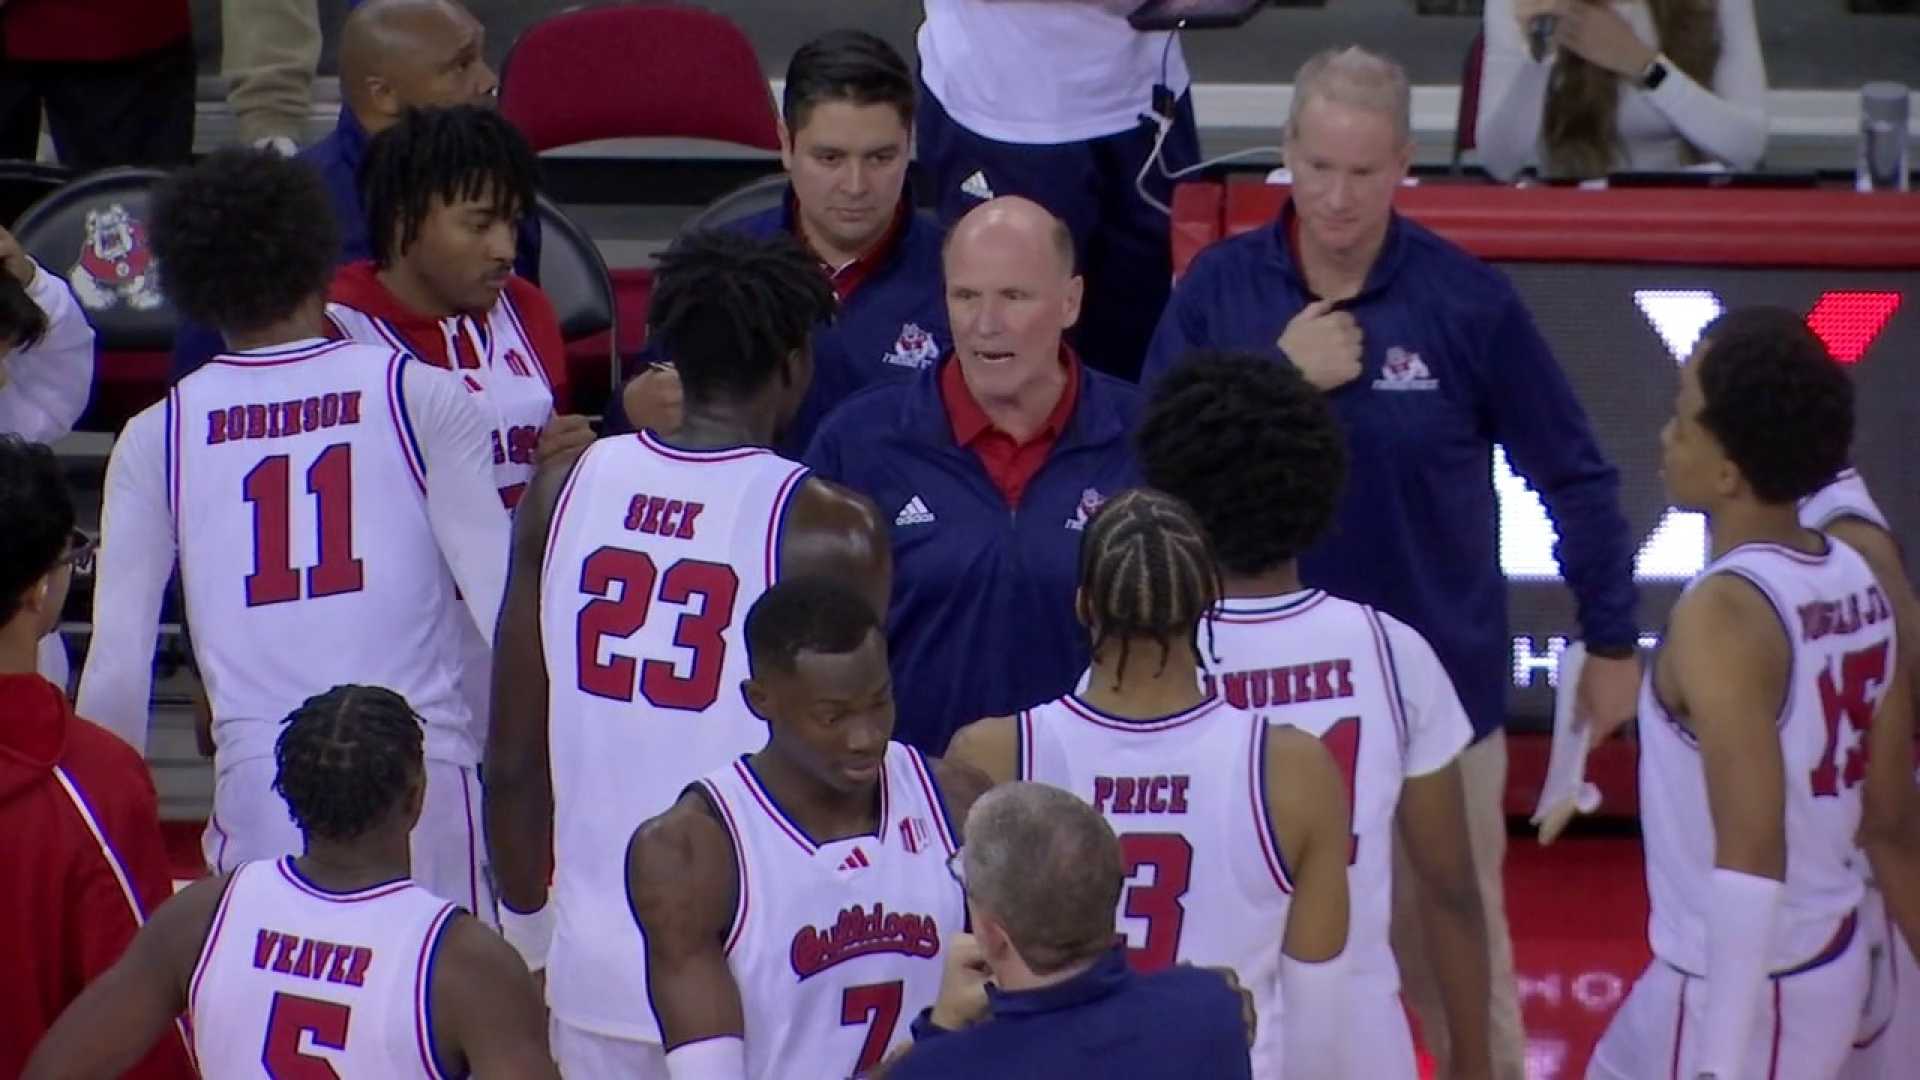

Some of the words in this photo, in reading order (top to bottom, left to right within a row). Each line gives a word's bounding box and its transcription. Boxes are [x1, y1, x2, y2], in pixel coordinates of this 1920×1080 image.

[207, 390, 362, 445] ROBINSON
[243, 442, 364, 608] 11
[623, 493, 704, 540] SECK
[576, 545, 739, 712] 23
[1094, 775, 1190, 814] PRICE
[1113, 833, 1194, 974] 3
[260, 990, 352, 1080] 5
[841, 980, 904, 1080] 7
